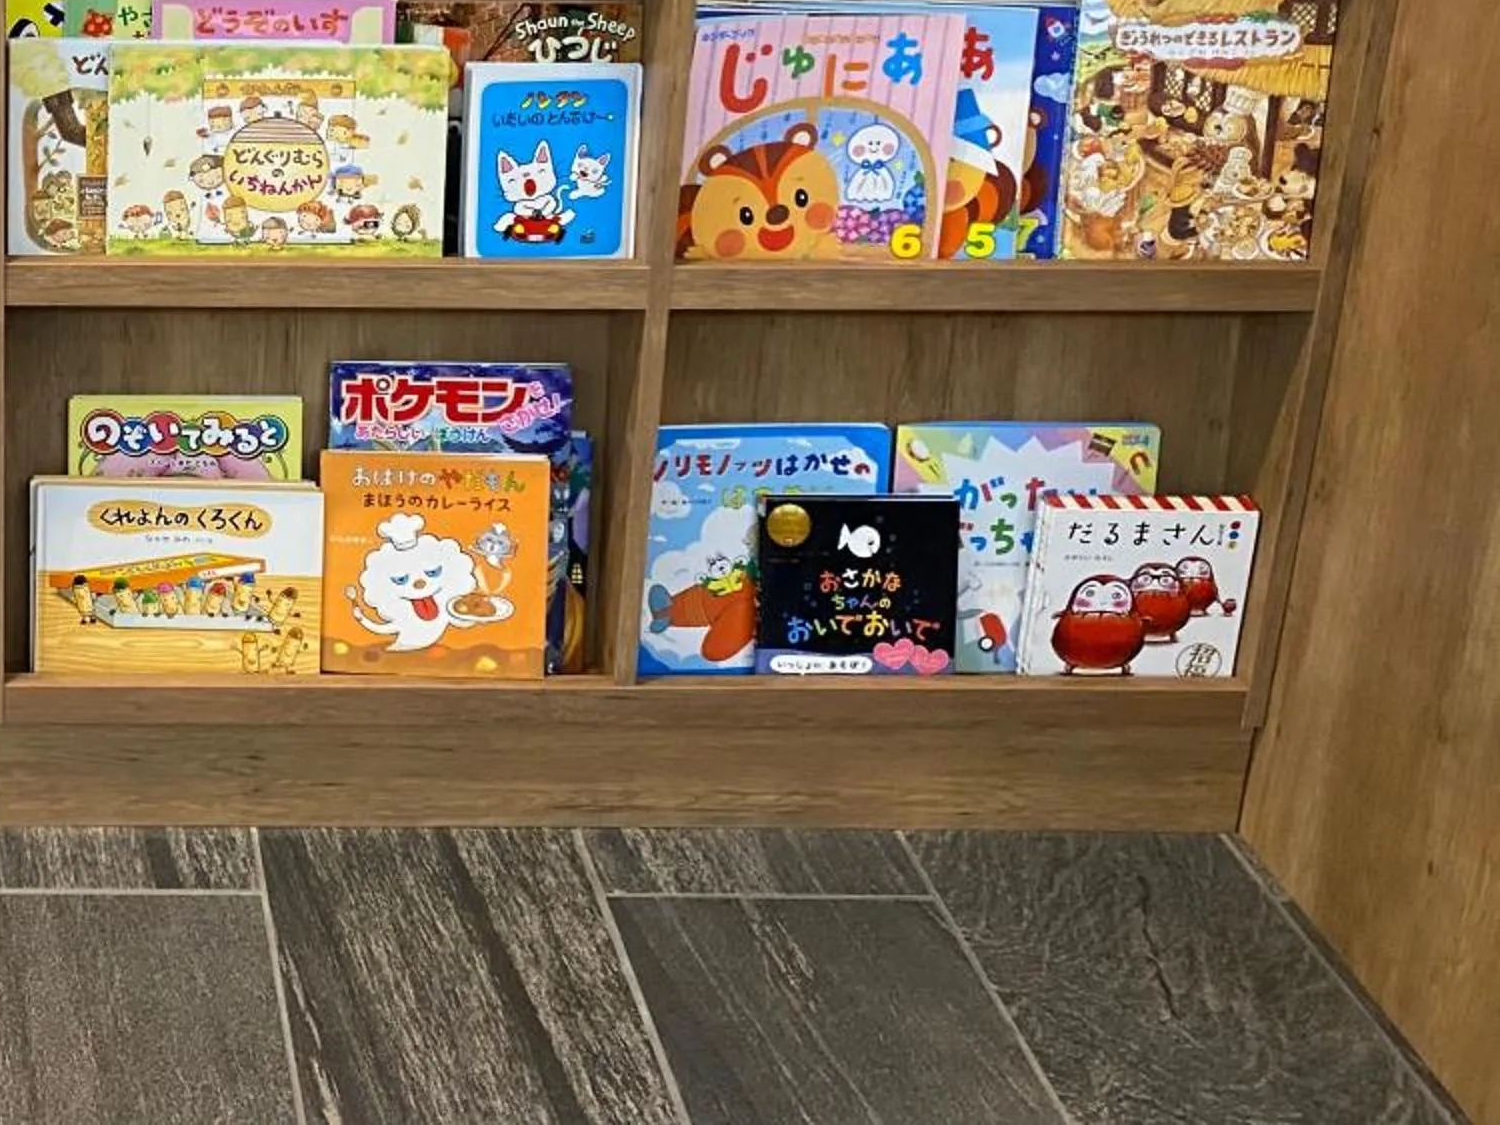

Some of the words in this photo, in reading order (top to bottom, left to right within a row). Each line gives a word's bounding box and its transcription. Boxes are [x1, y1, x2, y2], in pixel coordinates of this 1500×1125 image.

[195, 6, 349, 37] どうぞのいす
[515, 13, 569, 40] Shaun
[587, 12, 635, 41] Sheep
[528, 34, 618, 64] ひつじ
[719, 31, 924, 114] じゅにあ
[233, 147, 324, 170] どんぐりむら
[228, 171, 324, 197] いちねんかん
[272, 168, 285, 179] の
[890, 224, 922, 260] 6
[964, 222, 996, 258] 5
[341, 373, 528, 425] ポケモン
[86, 418, 279, 453] のぞいてみると
[653, 452, 872, 482] ノリモノッツはかせの
[362, 492, 513, 512] まほうのカレーライス
[99, 507, 190, 527] くれよんの
[197, 508, 264, 532] くろくん
[1068, 520, 1215, 547] だるまさん
[819, 567, 902, 594] おさかな
[831, 595, 893, 611] ちゃんの
[786, 609, 942, 644] おいでおいで
